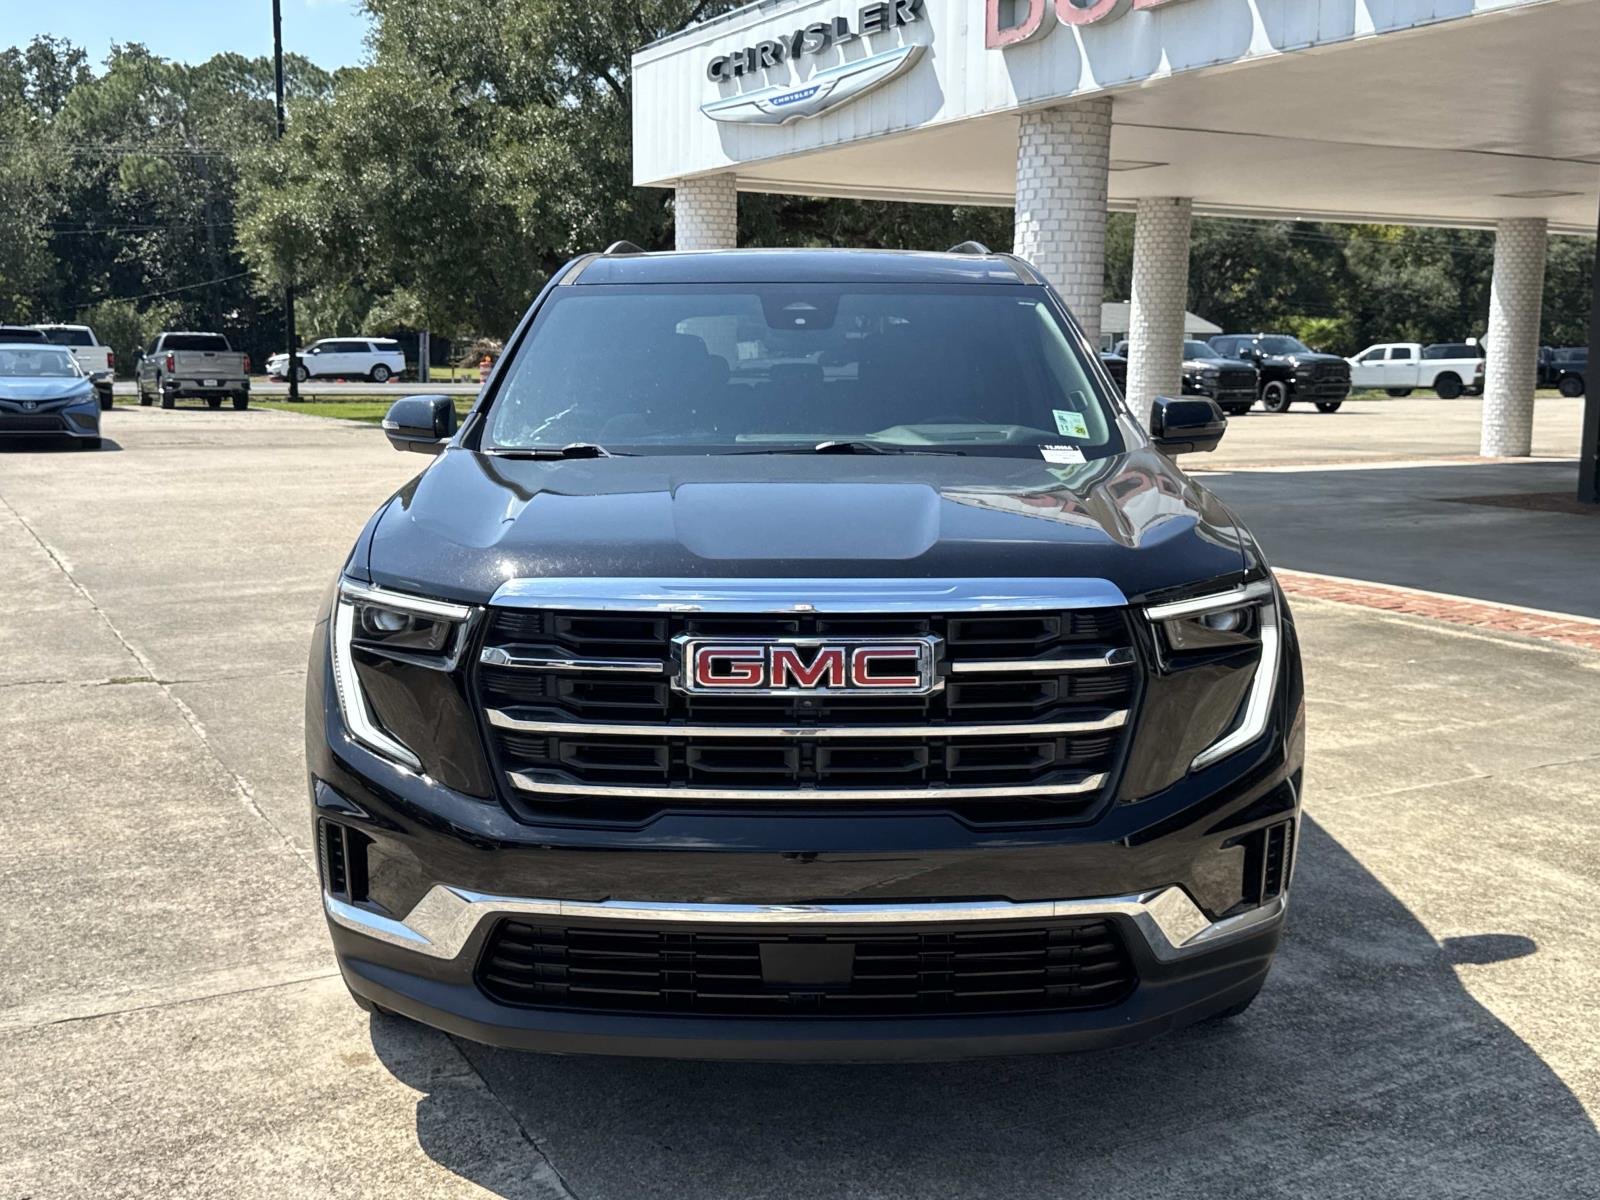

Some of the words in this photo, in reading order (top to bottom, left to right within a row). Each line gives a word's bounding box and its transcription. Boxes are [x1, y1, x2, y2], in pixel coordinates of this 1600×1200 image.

[707, 0, 919, 82] CHRYSLER
[773, 89, 815, 104] CHRYSLER
[695, 646, 921, 687] GMC
